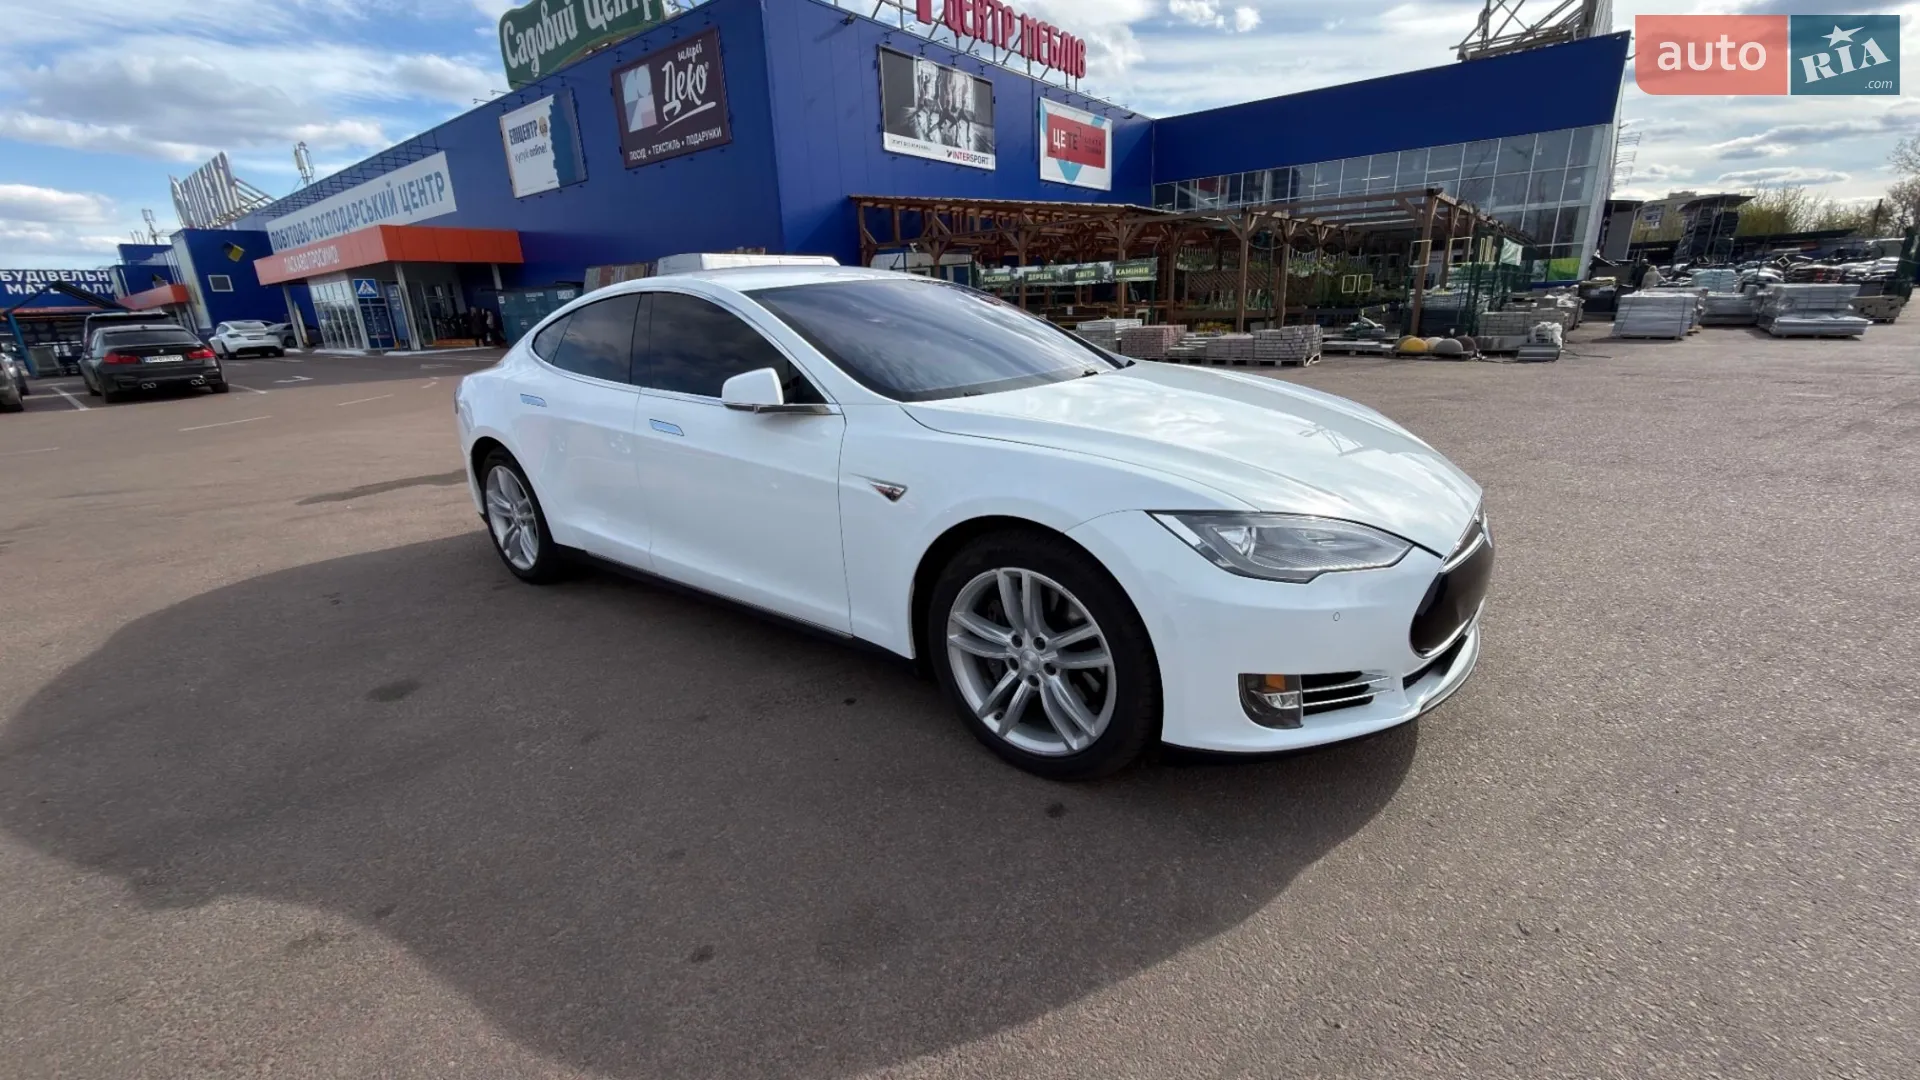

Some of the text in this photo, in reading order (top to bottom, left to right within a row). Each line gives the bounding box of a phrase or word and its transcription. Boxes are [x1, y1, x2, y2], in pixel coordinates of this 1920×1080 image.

[952, 150, 990, 165] INTERSPORT
[270, 171, 446, 252] ПОБУТОВО-ГОСПОДАРСЬКИЙ ЦЕНТР
[0, 270, 110, 283] БУДІВЕЛЬН
[1026, 272, 1053, 282] ДЕРЕВА
[1074, 269, 1096, 279] КВІТИ
[1114, 266, 1150, 277] КАМІННЯ
